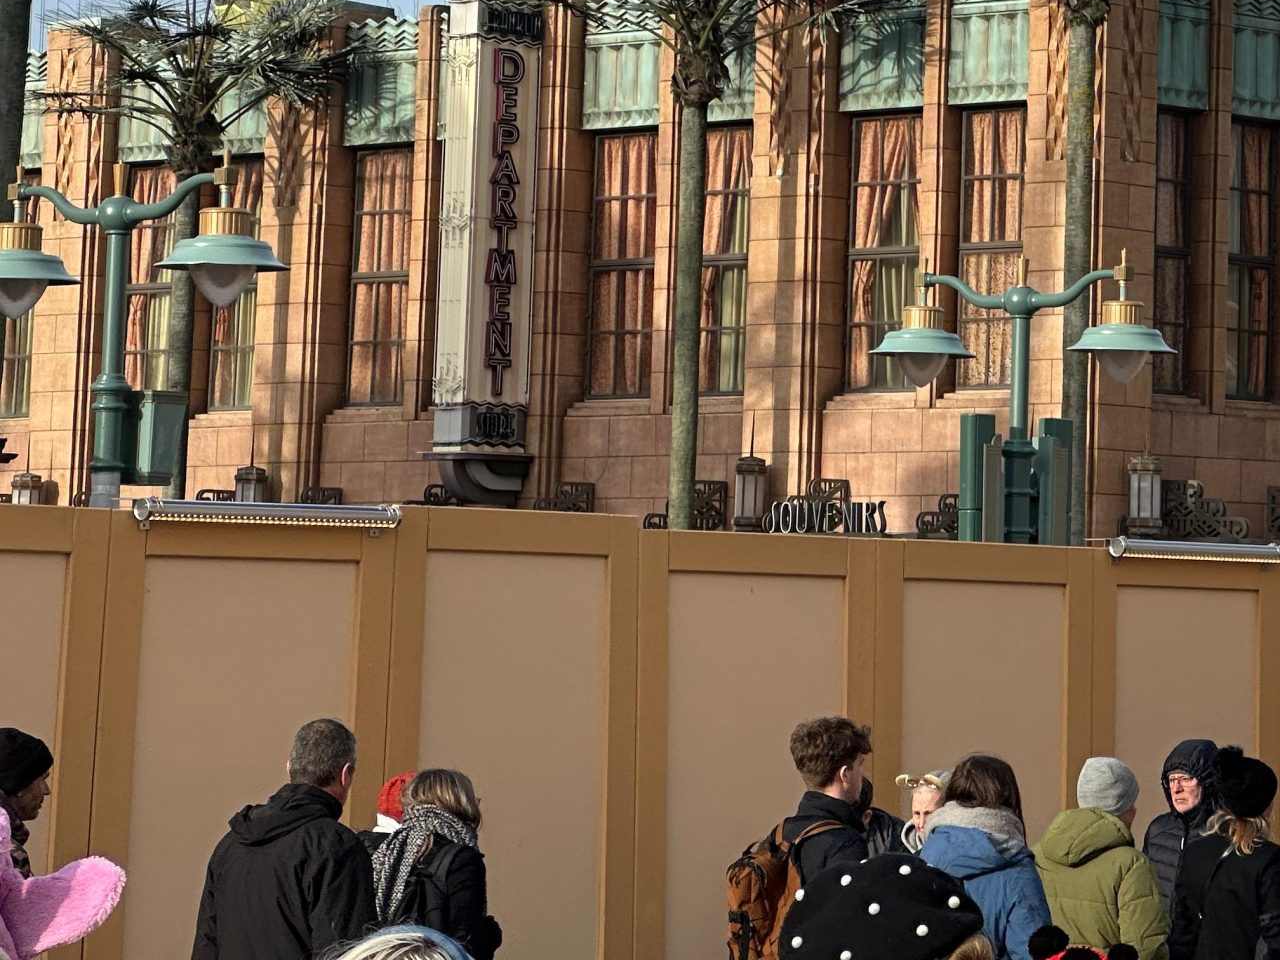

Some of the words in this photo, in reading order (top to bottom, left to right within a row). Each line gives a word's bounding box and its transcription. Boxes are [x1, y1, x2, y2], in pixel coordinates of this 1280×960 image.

[485, 48, 525, 396] DEPARTMENT
[477, 412, 516, 437] STORE
[768, 500, 888, 534] SOUVENIRS
